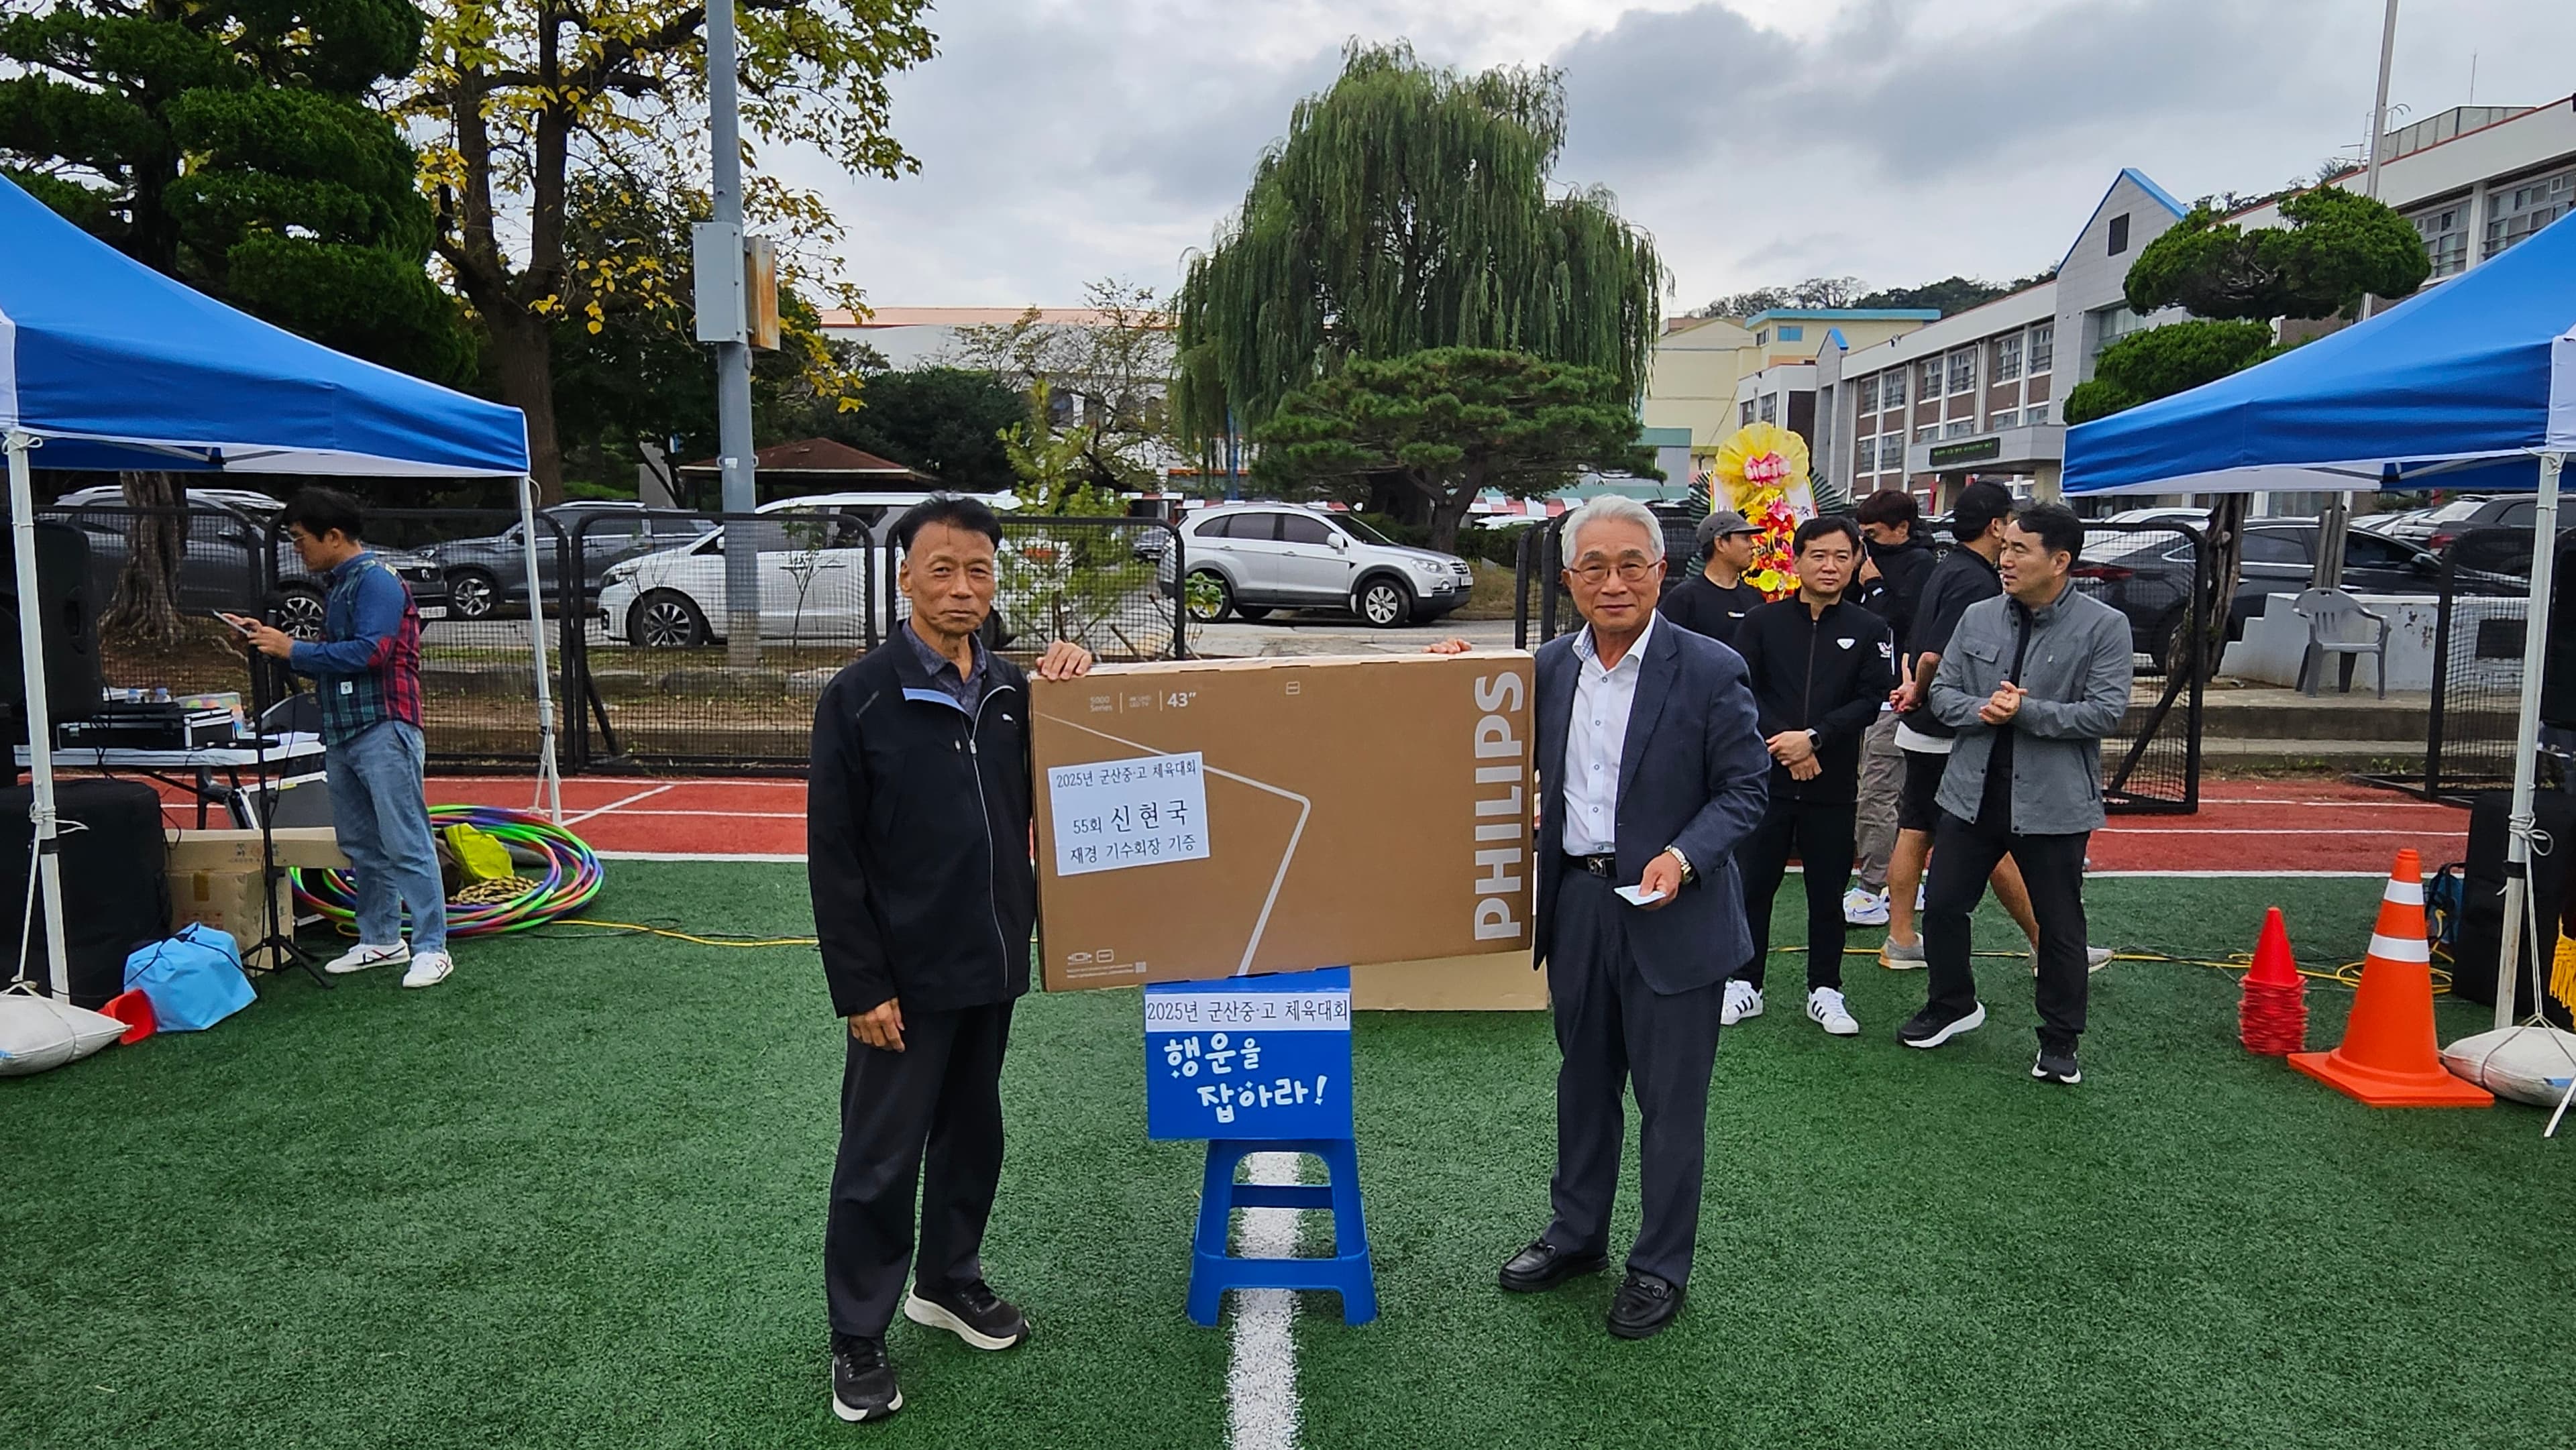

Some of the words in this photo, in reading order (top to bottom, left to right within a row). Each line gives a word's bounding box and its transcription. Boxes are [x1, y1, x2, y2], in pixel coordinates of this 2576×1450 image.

[1056, 771, 1093, 788] 2025년
[1152, 759, 1196, 778] 체육대회
[1474, 671, 1524, 940] PHILIPS
[1073, 816, 1102, 834] 55회
[1070, 845, 1097, 865] 재경
[1106, 837, 1161, 860] 기수회장
[1169, 834, 1196, 852] 기증
[1146, 1001, 1198, 1023] 2025년
[1285, 999, 1348, 1022] 체육대회
[1163, 1032, 1261, 1077] 행운을
[1196, 1074, 1328, 1123] 잡아라!
